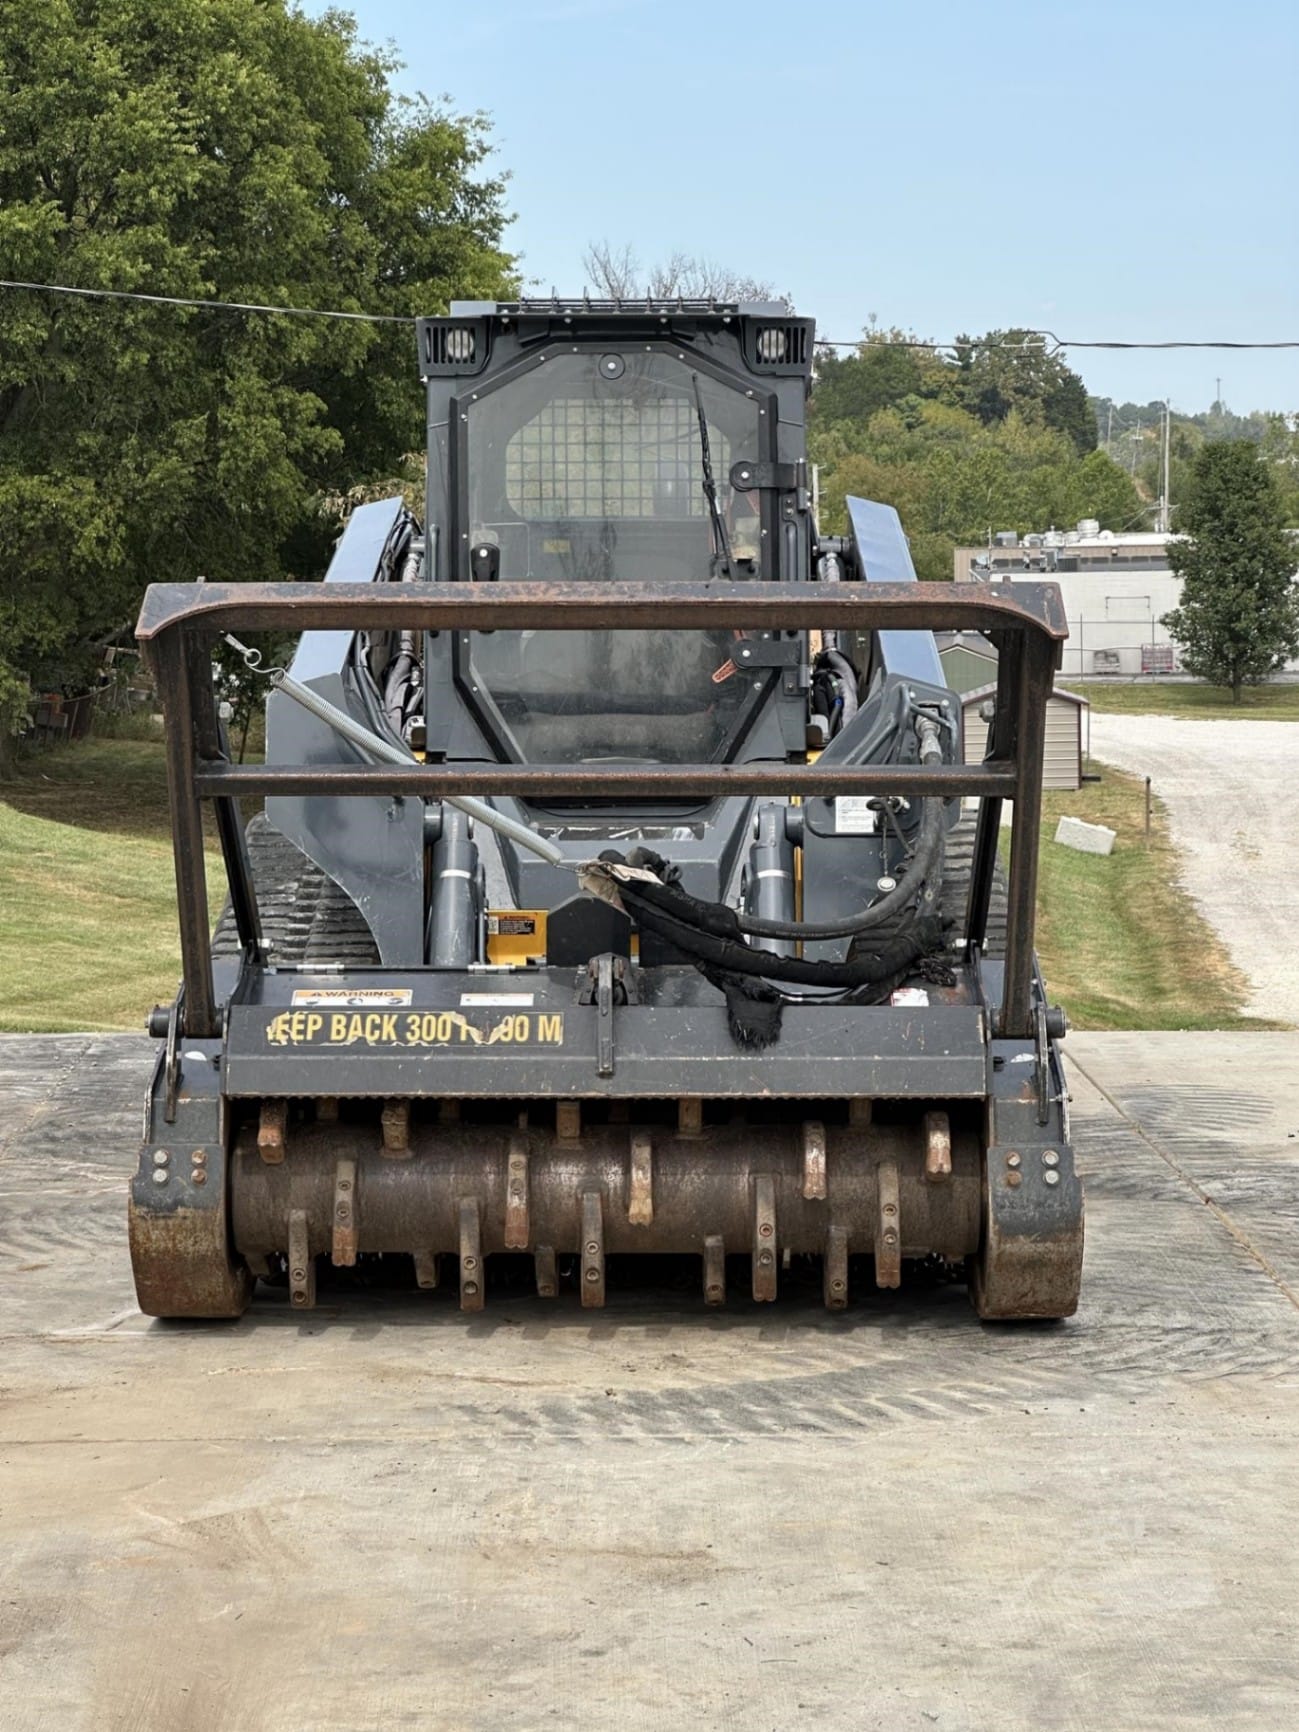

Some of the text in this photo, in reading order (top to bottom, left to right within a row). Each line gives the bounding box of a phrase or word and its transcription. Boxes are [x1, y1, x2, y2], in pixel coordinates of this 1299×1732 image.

[330, 1014, 399, 1042] BACK
[406, 1014, 453, 1042] 300
[537, 1015, 561, 1042] M
